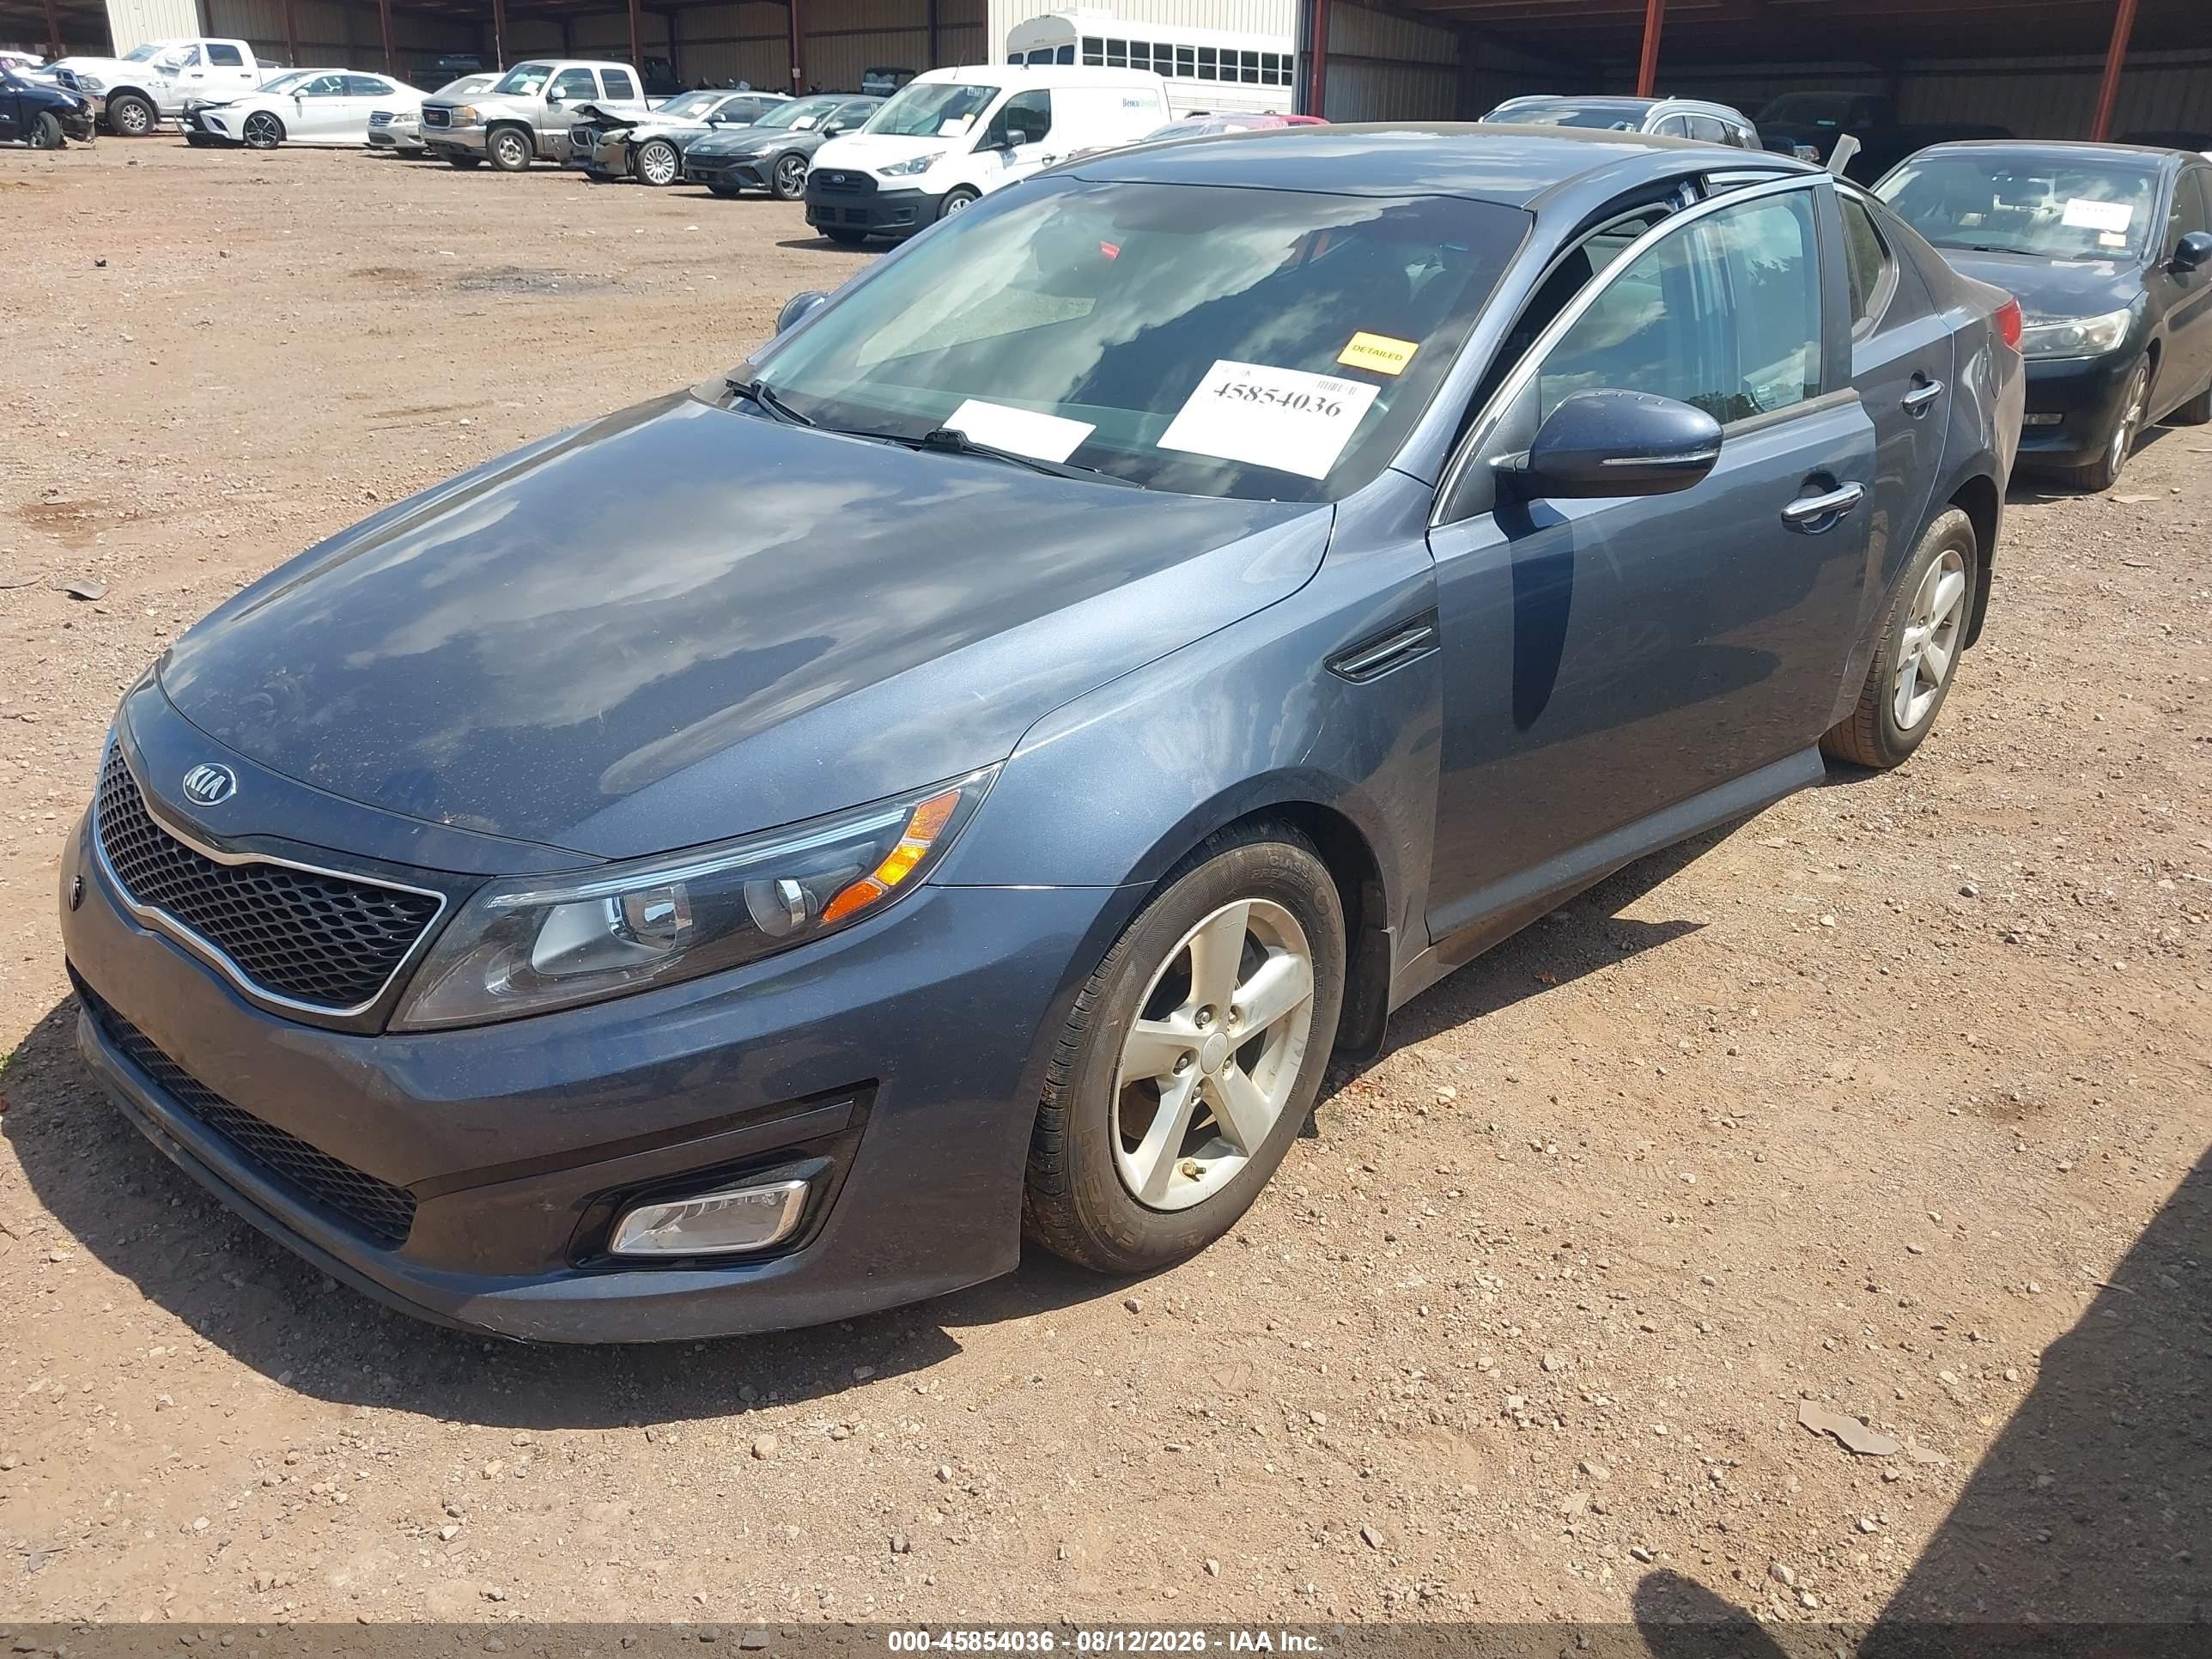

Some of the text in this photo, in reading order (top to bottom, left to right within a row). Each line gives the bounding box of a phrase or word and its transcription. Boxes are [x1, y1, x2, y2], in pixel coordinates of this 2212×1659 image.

[1352, 344, 1403, 361] DETAILED
[1213, 382, 1344, 417] 45854036
[185, 765, 227, 800] KIA
[1250, 866, 1312, 895] PREMERE
